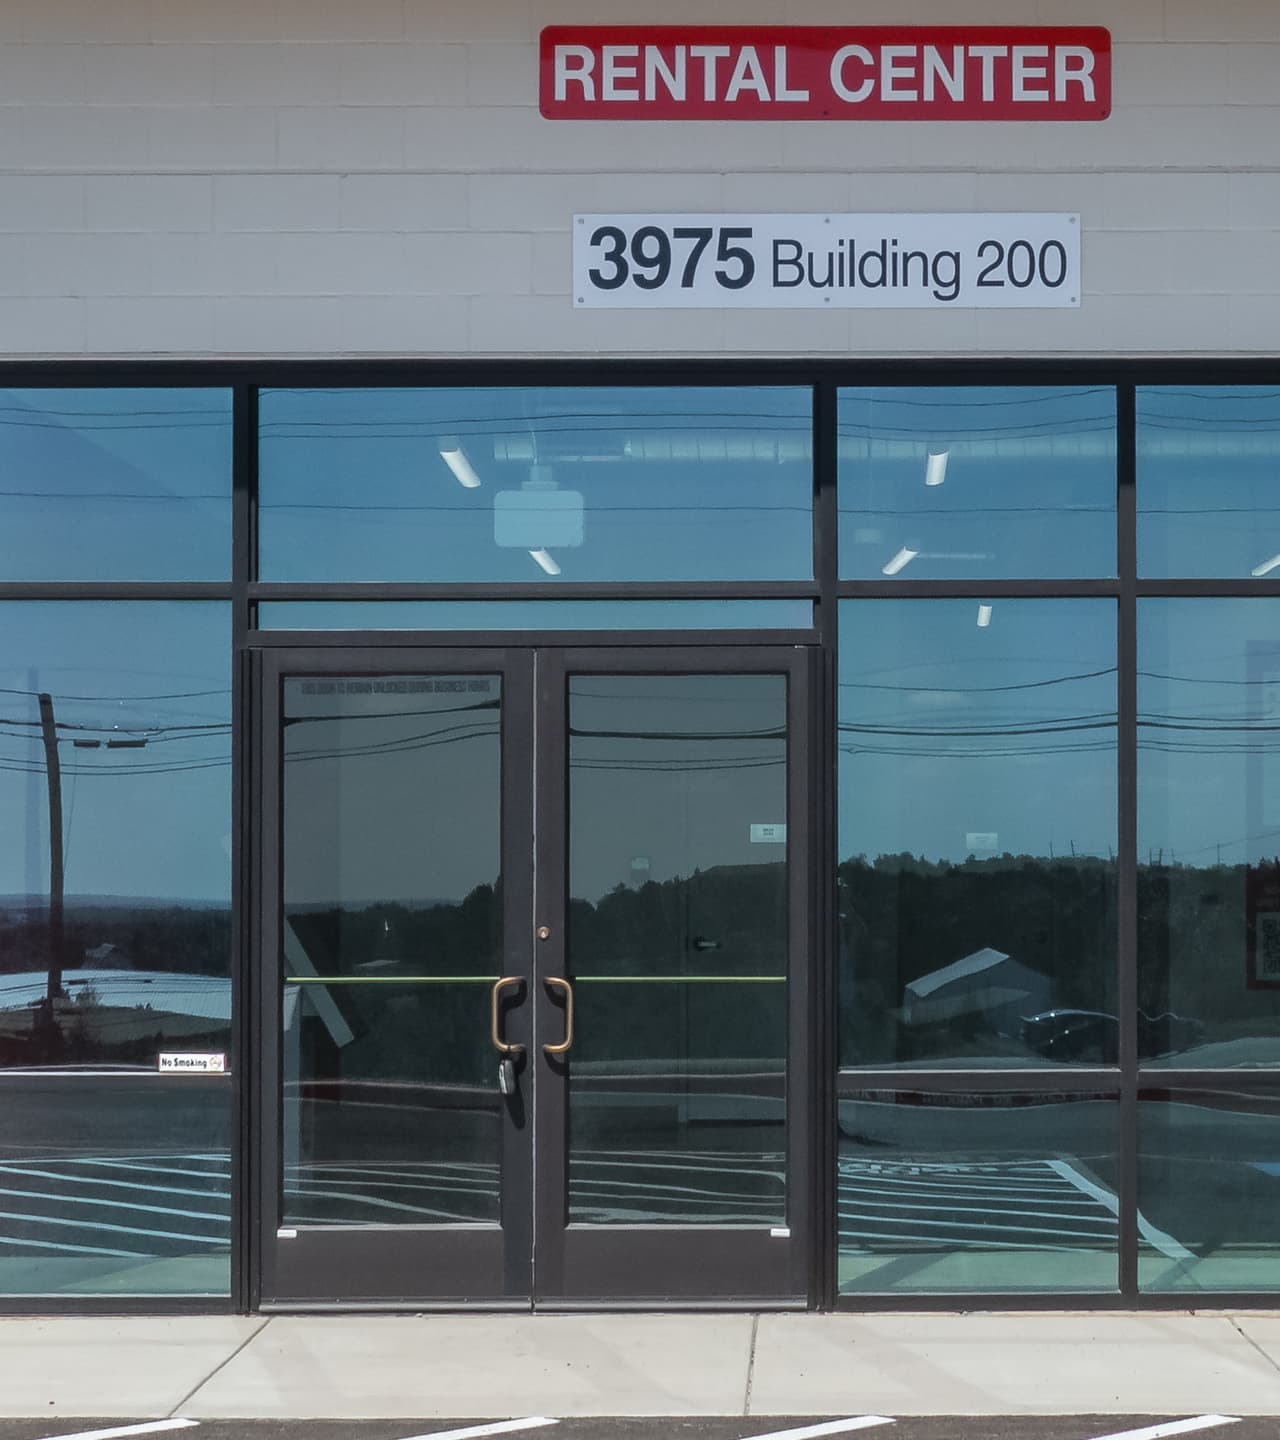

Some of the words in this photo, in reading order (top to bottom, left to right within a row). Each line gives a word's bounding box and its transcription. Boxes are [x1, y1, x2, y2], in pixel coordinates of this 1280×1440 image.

[553, 44, 811, 102] RENTAL
[829, 43, 1096, 103] CENTER
[588, 225, 756, 290] 3975
[772, 238, 961, 302] Building
[976, 239, 1068, 288] 200
[161, 1058, 172, 1067] No
[174, 1057, 207, 1069] Smoking
